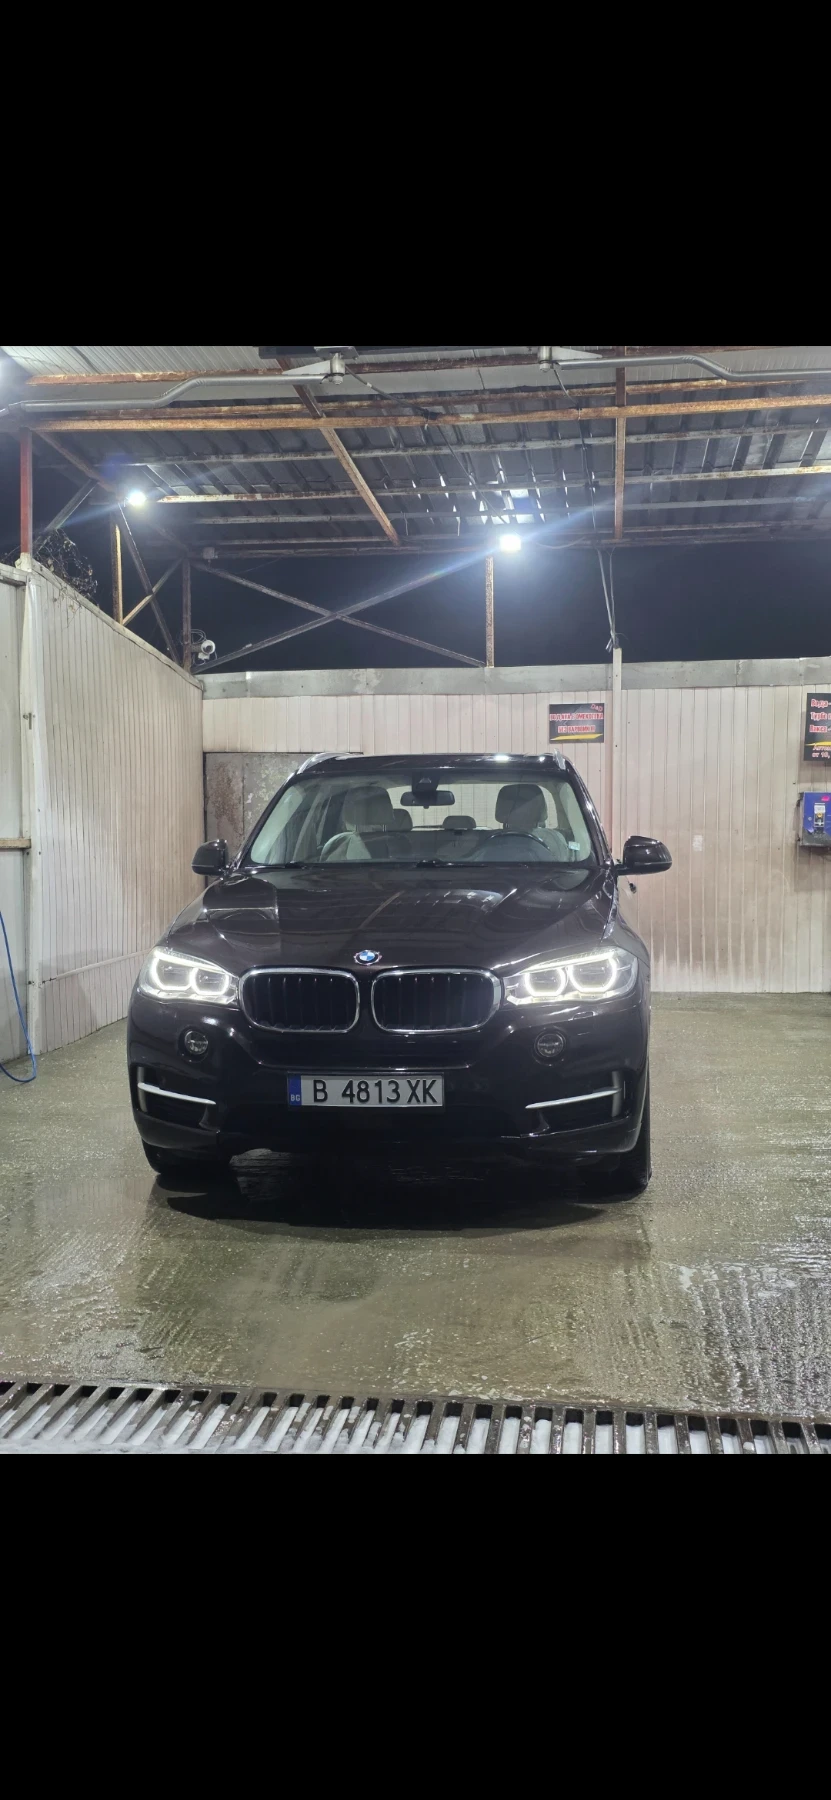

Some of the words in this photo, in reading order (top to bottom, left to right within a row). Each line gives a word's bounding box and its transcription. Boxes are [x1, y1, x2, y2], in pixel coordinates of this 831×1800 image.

[290, 1094, 300, 1102] BG
[313, 1079, 328, 1103] B
[341, 1079, 401, 1104] 4813
[406, 1079, 438, 1104] XK
